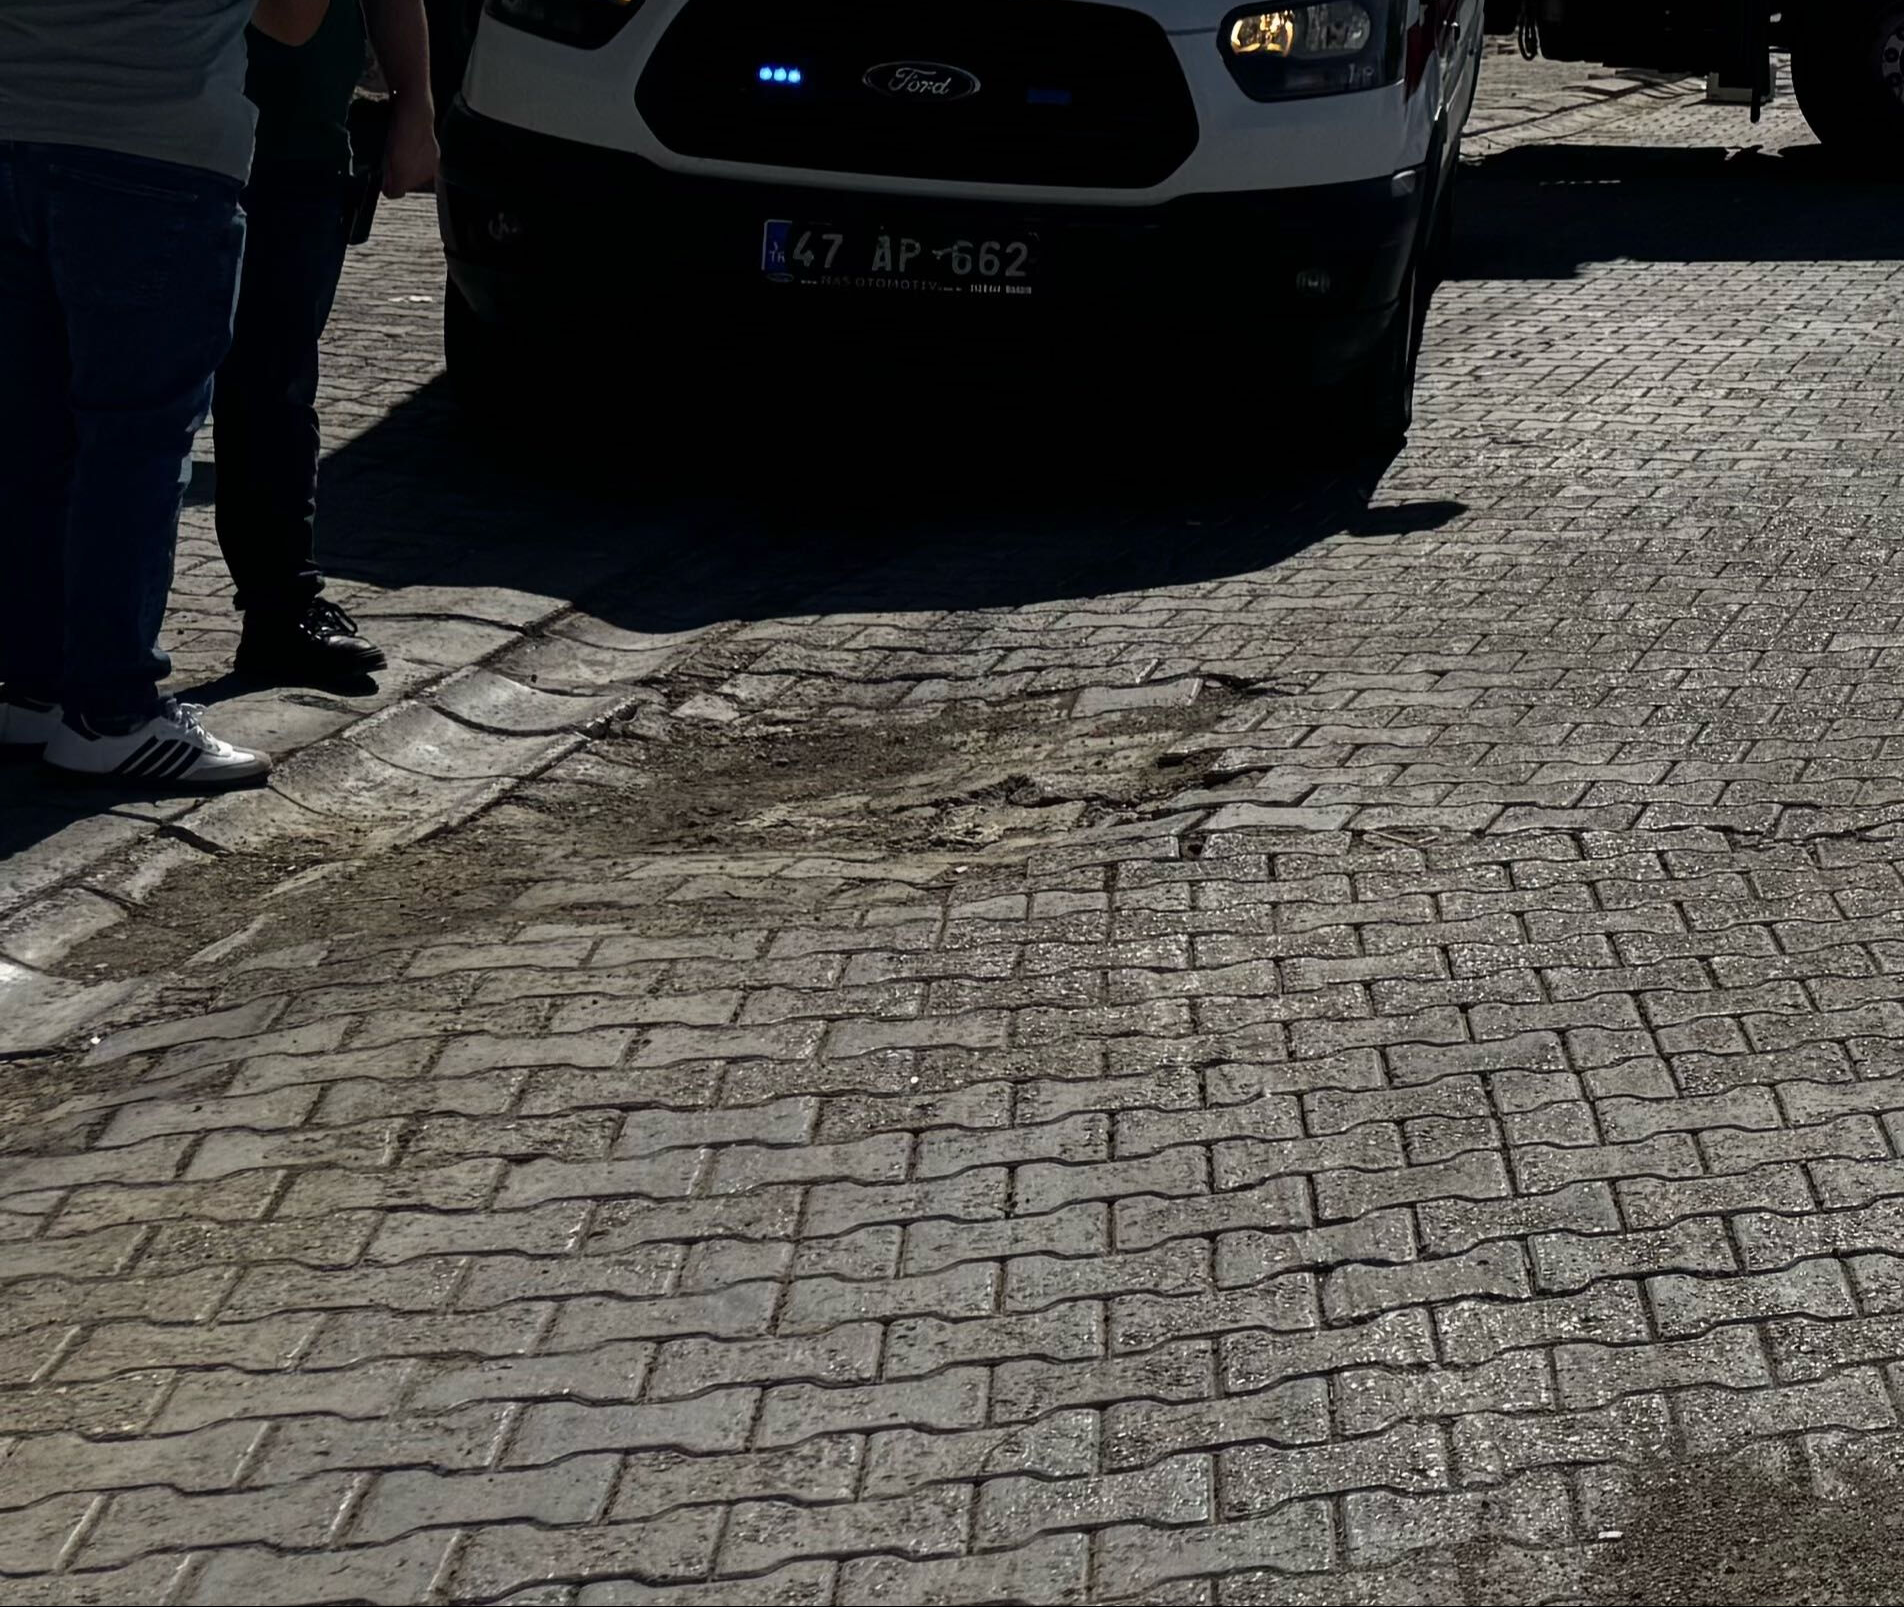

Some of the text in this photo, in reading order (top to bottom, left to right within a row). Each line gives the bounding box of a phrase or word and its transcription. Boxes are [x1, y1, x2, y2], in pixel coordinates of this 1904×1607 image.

[887, 66, 952, 96] Ford
[792, 230, 1030, 278] 47 AP 662
